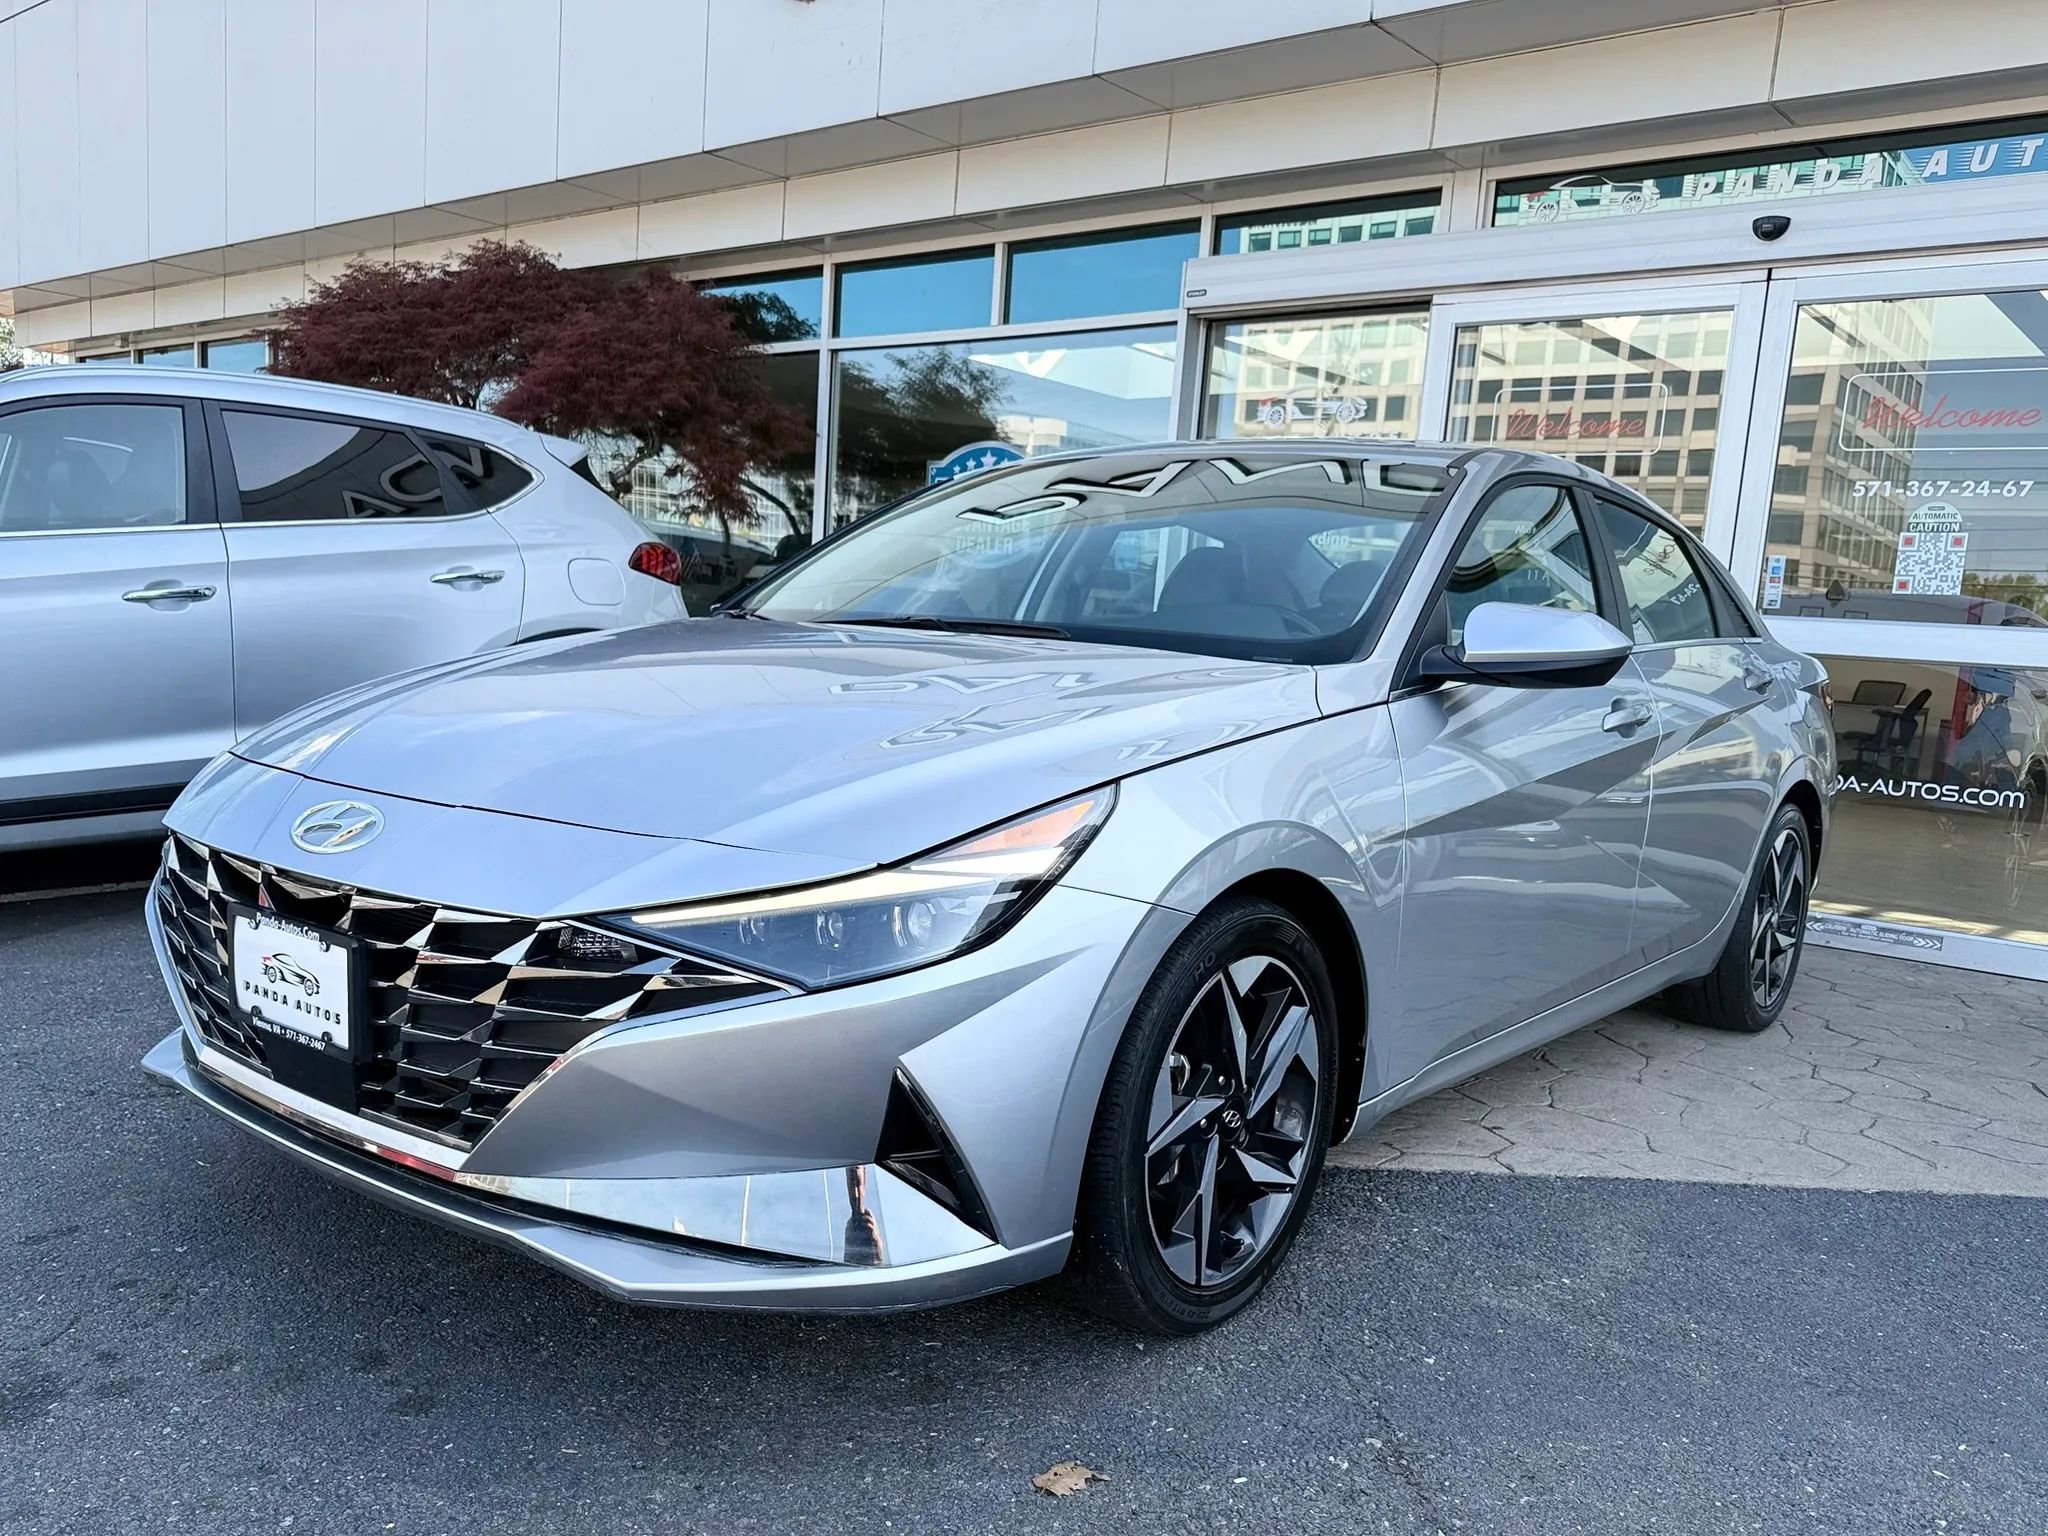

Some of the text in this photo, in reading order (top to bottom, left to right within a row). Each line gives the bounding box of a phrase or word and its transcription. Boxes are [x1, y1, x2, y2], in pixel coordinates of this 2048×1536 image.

[1690, 138, 2045, 199] PANDA AUT
[1508, 406, 1646, 437] Welcome
[1862, 394, 2042, 430] Welcome
[1852, 480, 2035, 497] 571-367-24-67
[1909, 522, 1960, 532] CAUTION
[1912, 512, 1959, 520] AUTOMATIC
[256, 911, 321, 942] Panda-Autos.Com
[244, 981, 341, 1025] PANDA AUTOS
[272, 1024, 281, 1035] VA
[285, 1029, 326, 1051] 571-367-2467
